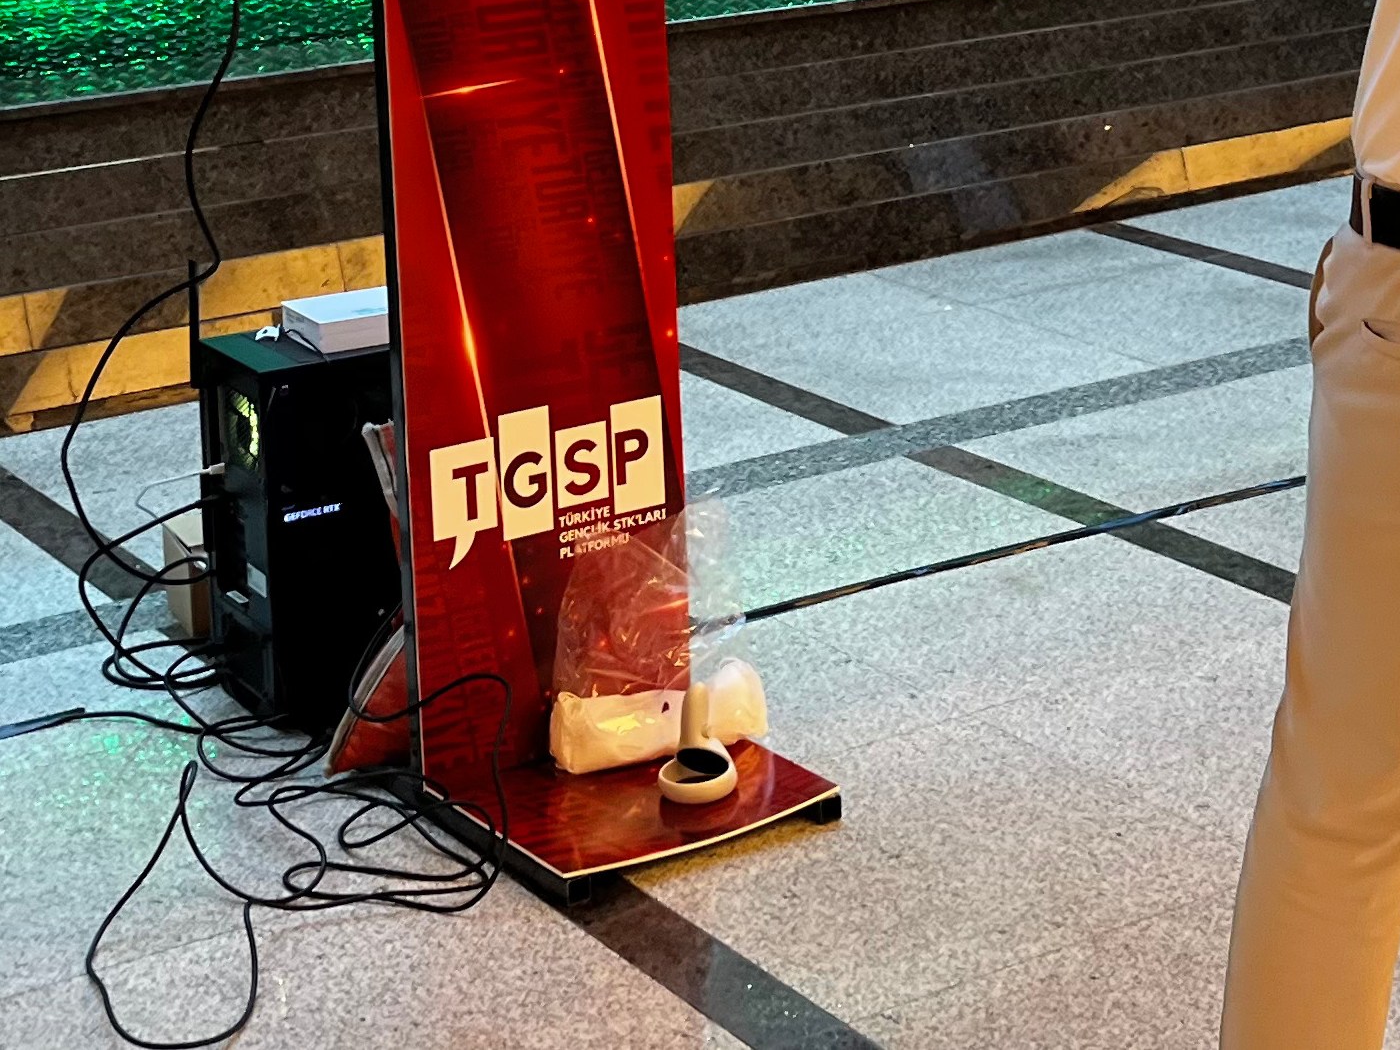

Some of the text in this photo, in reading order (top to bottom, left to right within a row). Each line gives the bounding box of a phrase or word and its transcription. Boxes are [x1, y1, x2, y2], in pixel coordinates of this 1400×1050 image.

[559, 505, 611, 529] TÜRKİYE
[559, 508, 667, 544] GENÇLİK STK'LARI
[559, 532, 631, 560] PLATFORMU
